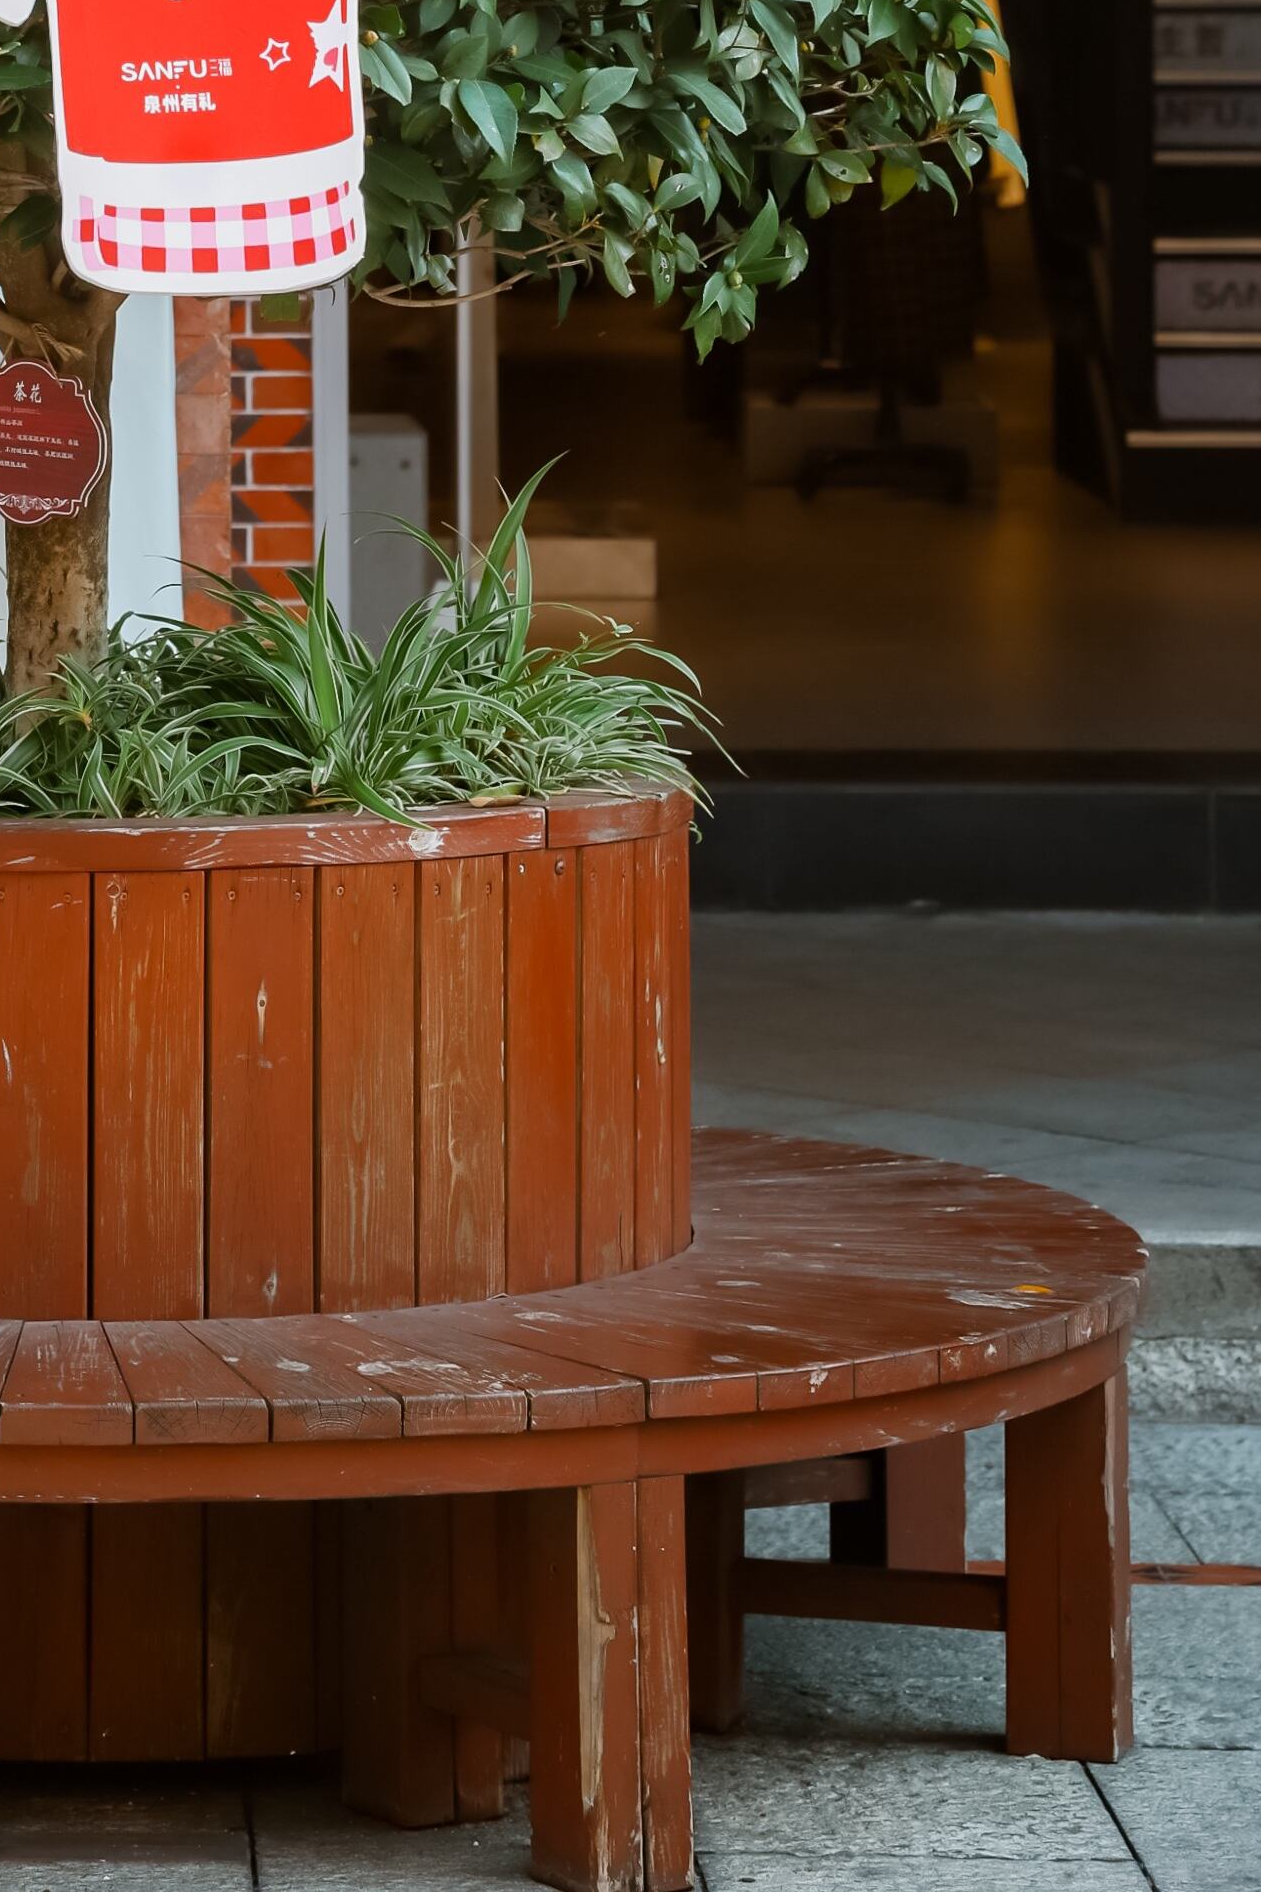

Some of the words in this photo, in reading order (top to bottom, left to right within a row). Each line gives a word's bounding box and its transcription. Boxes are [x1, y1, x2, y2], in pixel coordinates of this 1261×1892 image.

[121, 59, 208, 81] SANFU
[144, 92, 216, 114] 泉州有礼
[14, 380, 42, 403] 茶花
